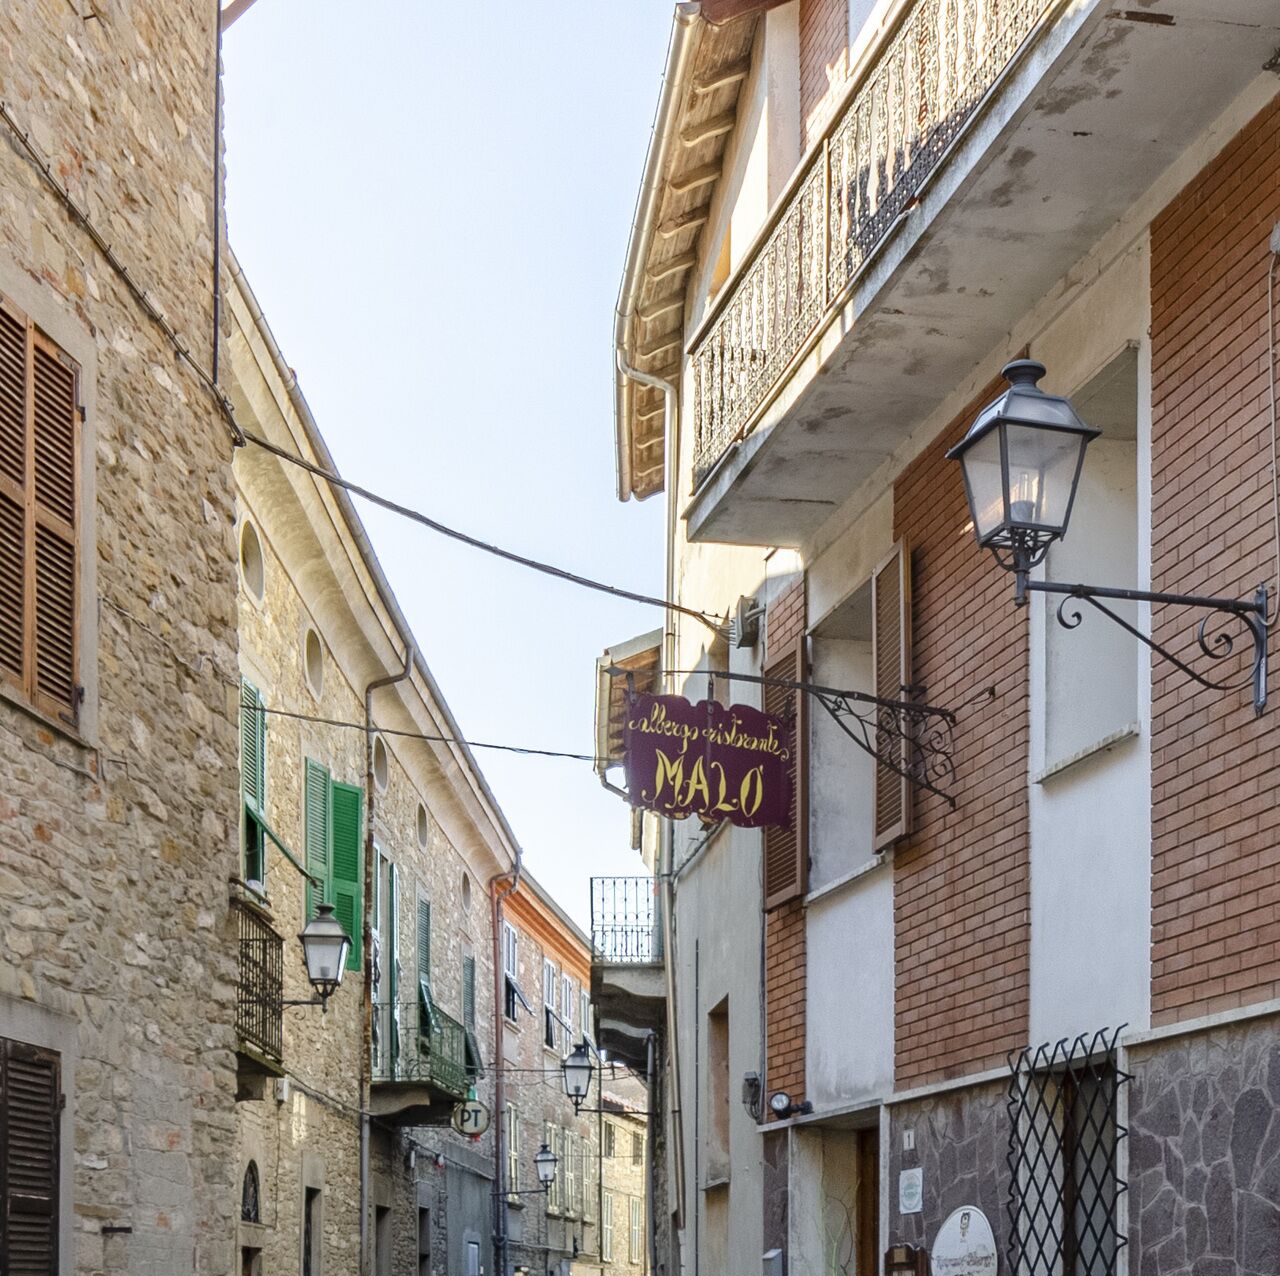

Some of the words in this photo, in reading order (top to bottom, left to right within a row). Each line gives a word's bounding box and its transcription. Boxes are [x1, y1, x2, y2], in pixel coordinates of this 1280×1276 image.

[628, 702, 699, 754] albergo
[702, 713, 789, 761] ristorante
[460, 1109, 481, 1127] PT
